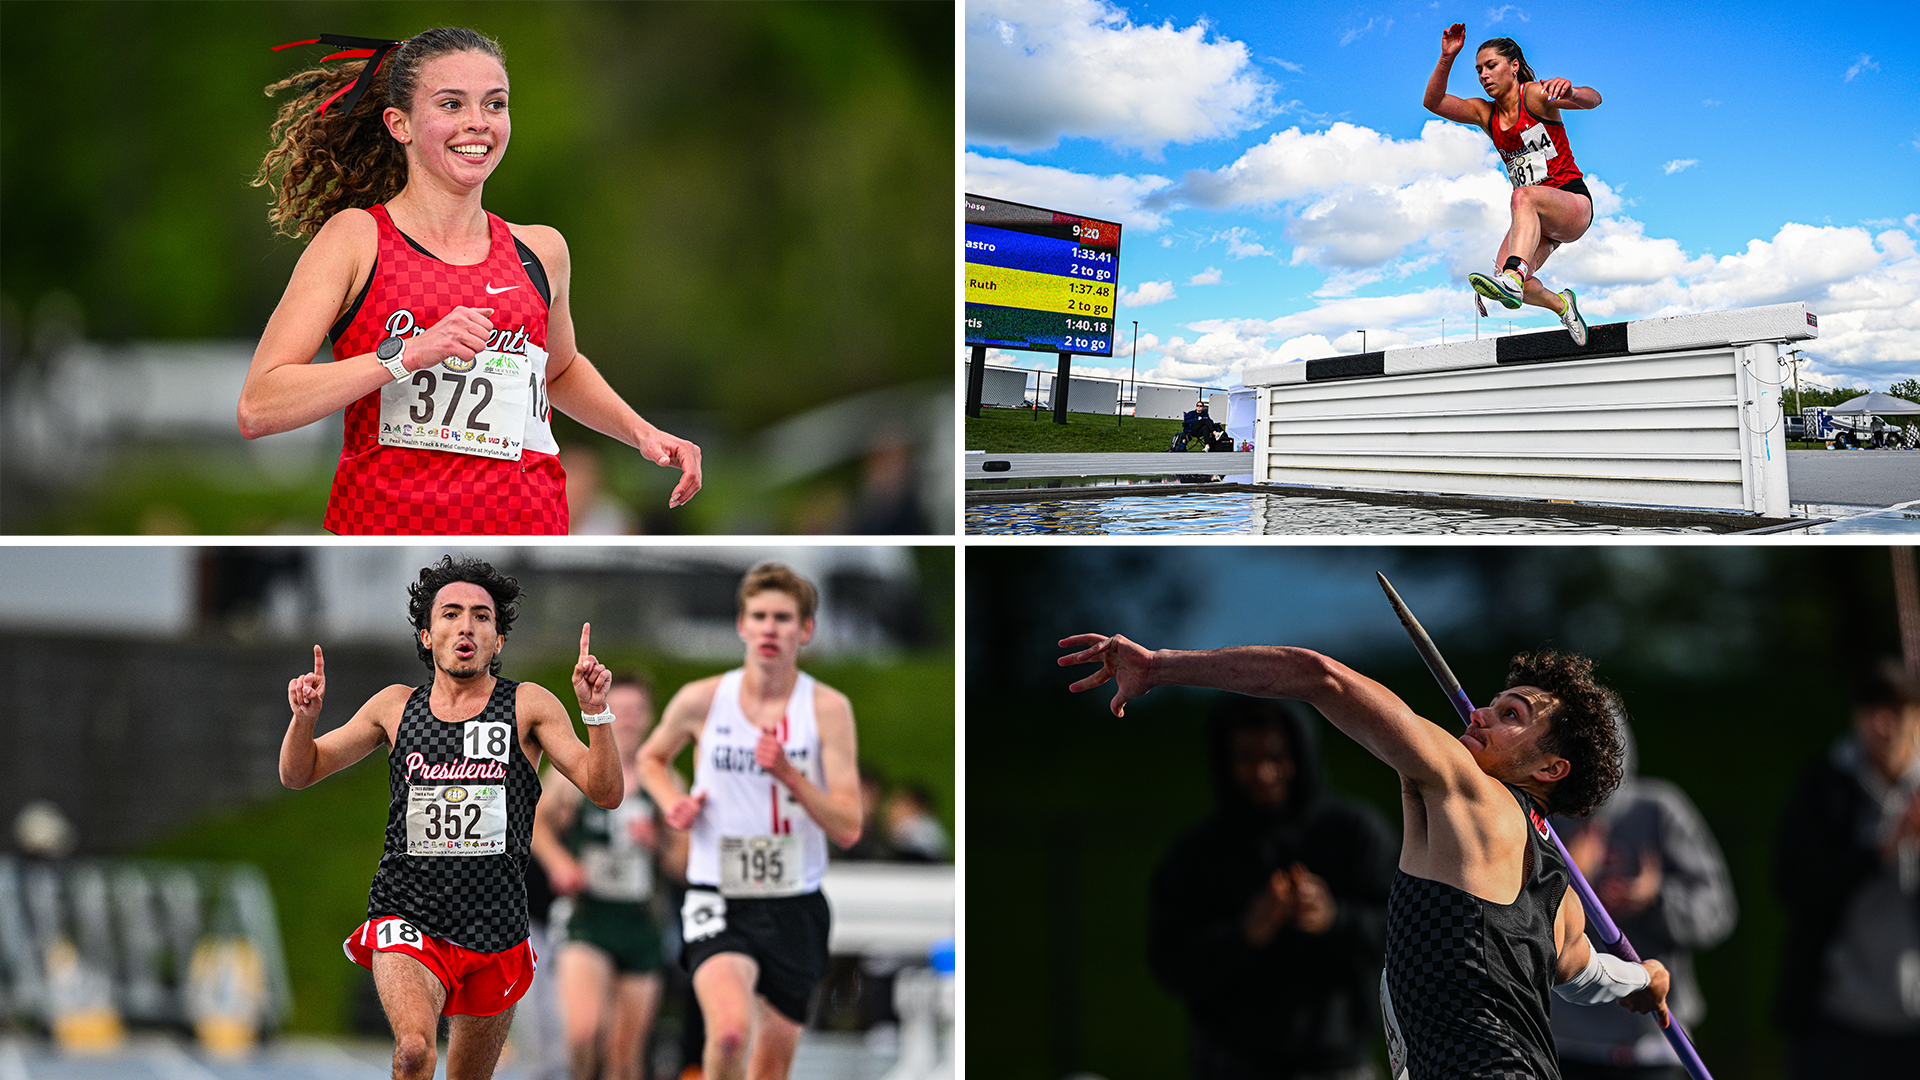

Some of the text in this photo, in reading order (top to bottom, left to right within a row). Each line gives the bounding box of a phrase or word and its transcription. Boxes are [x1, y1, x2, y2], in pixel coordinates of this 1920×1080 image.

[1528, 132, 1551, 152] 14
[1499, 146, 1531, 159] Presid
[965, 200, 986, 212] hase
[1072, 225, 1099, 240] 9:20
[965, 240, 1111, 263] astro 1:33.41
[1071, 263, 1111, 280] 2 to go
[969, 279, 1109, 297] Ruth 1:37.48
[1068, 299, 1108, 315] 2 to go
[385, 309, 530, 353] Prents
[1065, 318, 1107, 333] 1:40.18
[1064, 335, 1106, 350] 2 to go
[409, 370, 494, 431] 372
[529, 372, 549, 423] 10
[440, 427, 450, 439] G
[454, 444, 477, 453] Complex
[466, 726, 506, 757] 18
[405, 751, 507, 781] Presidents
[447, 790, 463, 799] PAC
[425, 803, 481, 840] 352
[447, 840, 453, 848] G
[739, 851, 783, 881] 195
[379, 923, 419, 944] 18
